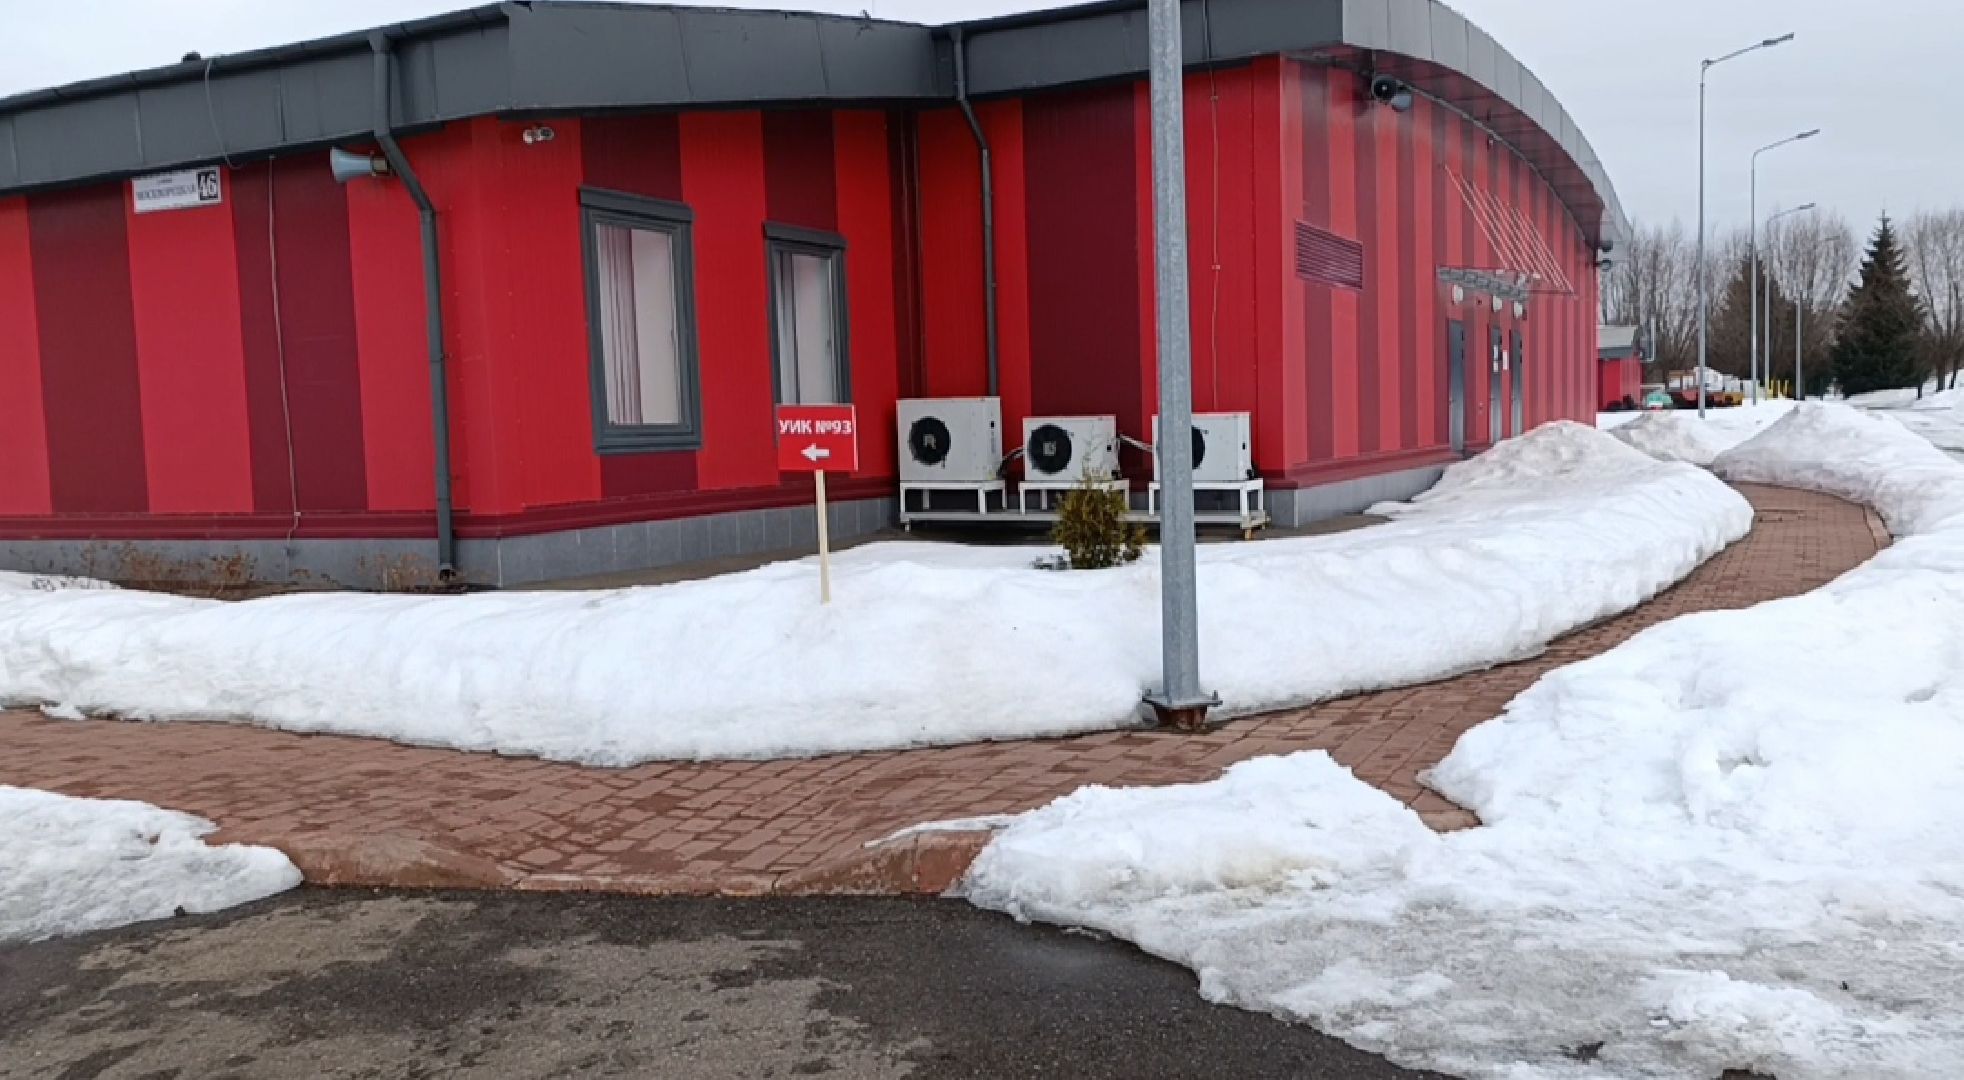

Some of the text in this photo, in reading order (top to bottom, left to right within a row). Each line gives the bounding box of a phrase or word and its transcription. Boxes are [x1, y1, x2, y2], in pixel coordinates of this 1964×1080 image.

[199, 172, 218, 198] 46
[779, 419, 852, 434] УИК №93
